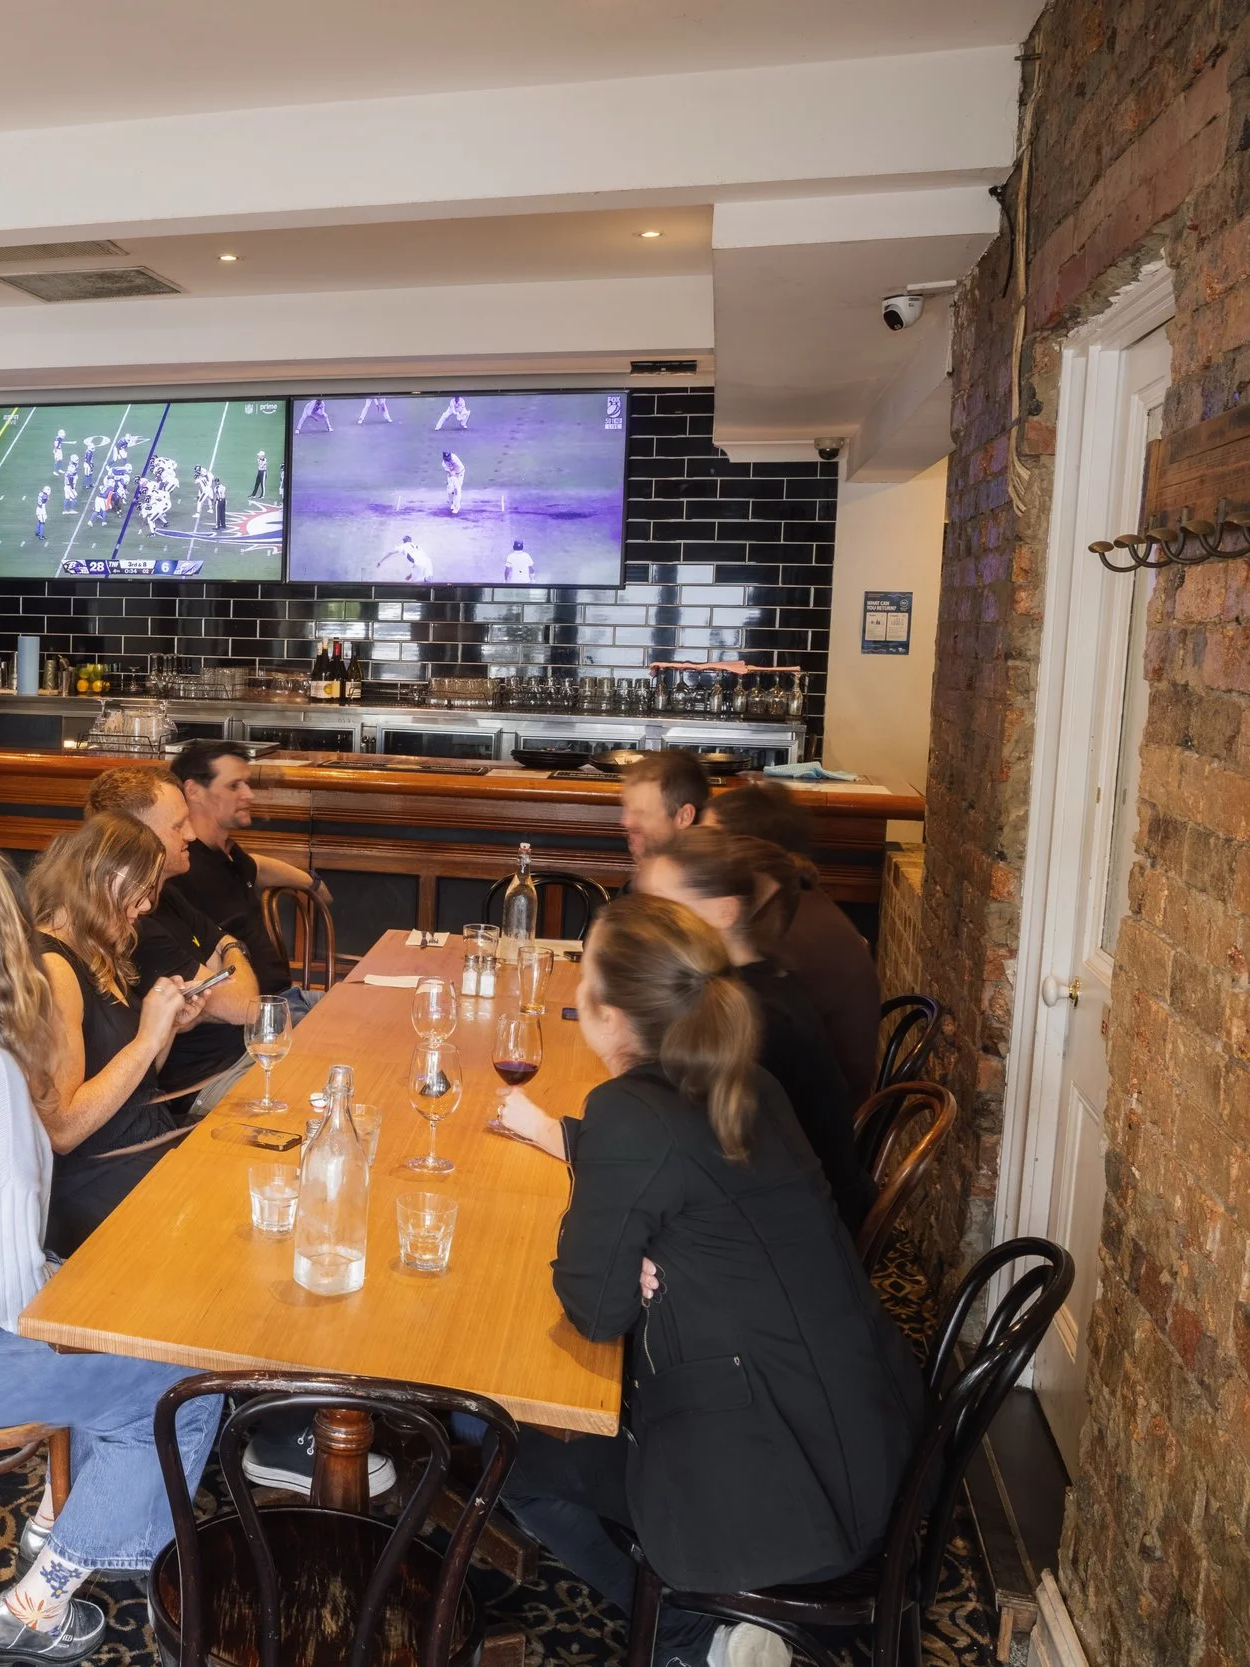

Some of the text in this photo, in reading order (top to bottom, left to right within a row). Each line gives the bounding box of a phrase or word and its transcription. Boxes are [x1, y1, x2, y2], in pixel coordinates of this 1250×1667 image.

[260, 403, 277, 411] prime
[89, 561, 105, 572] 28
[161, 562, 170, 573] 6
